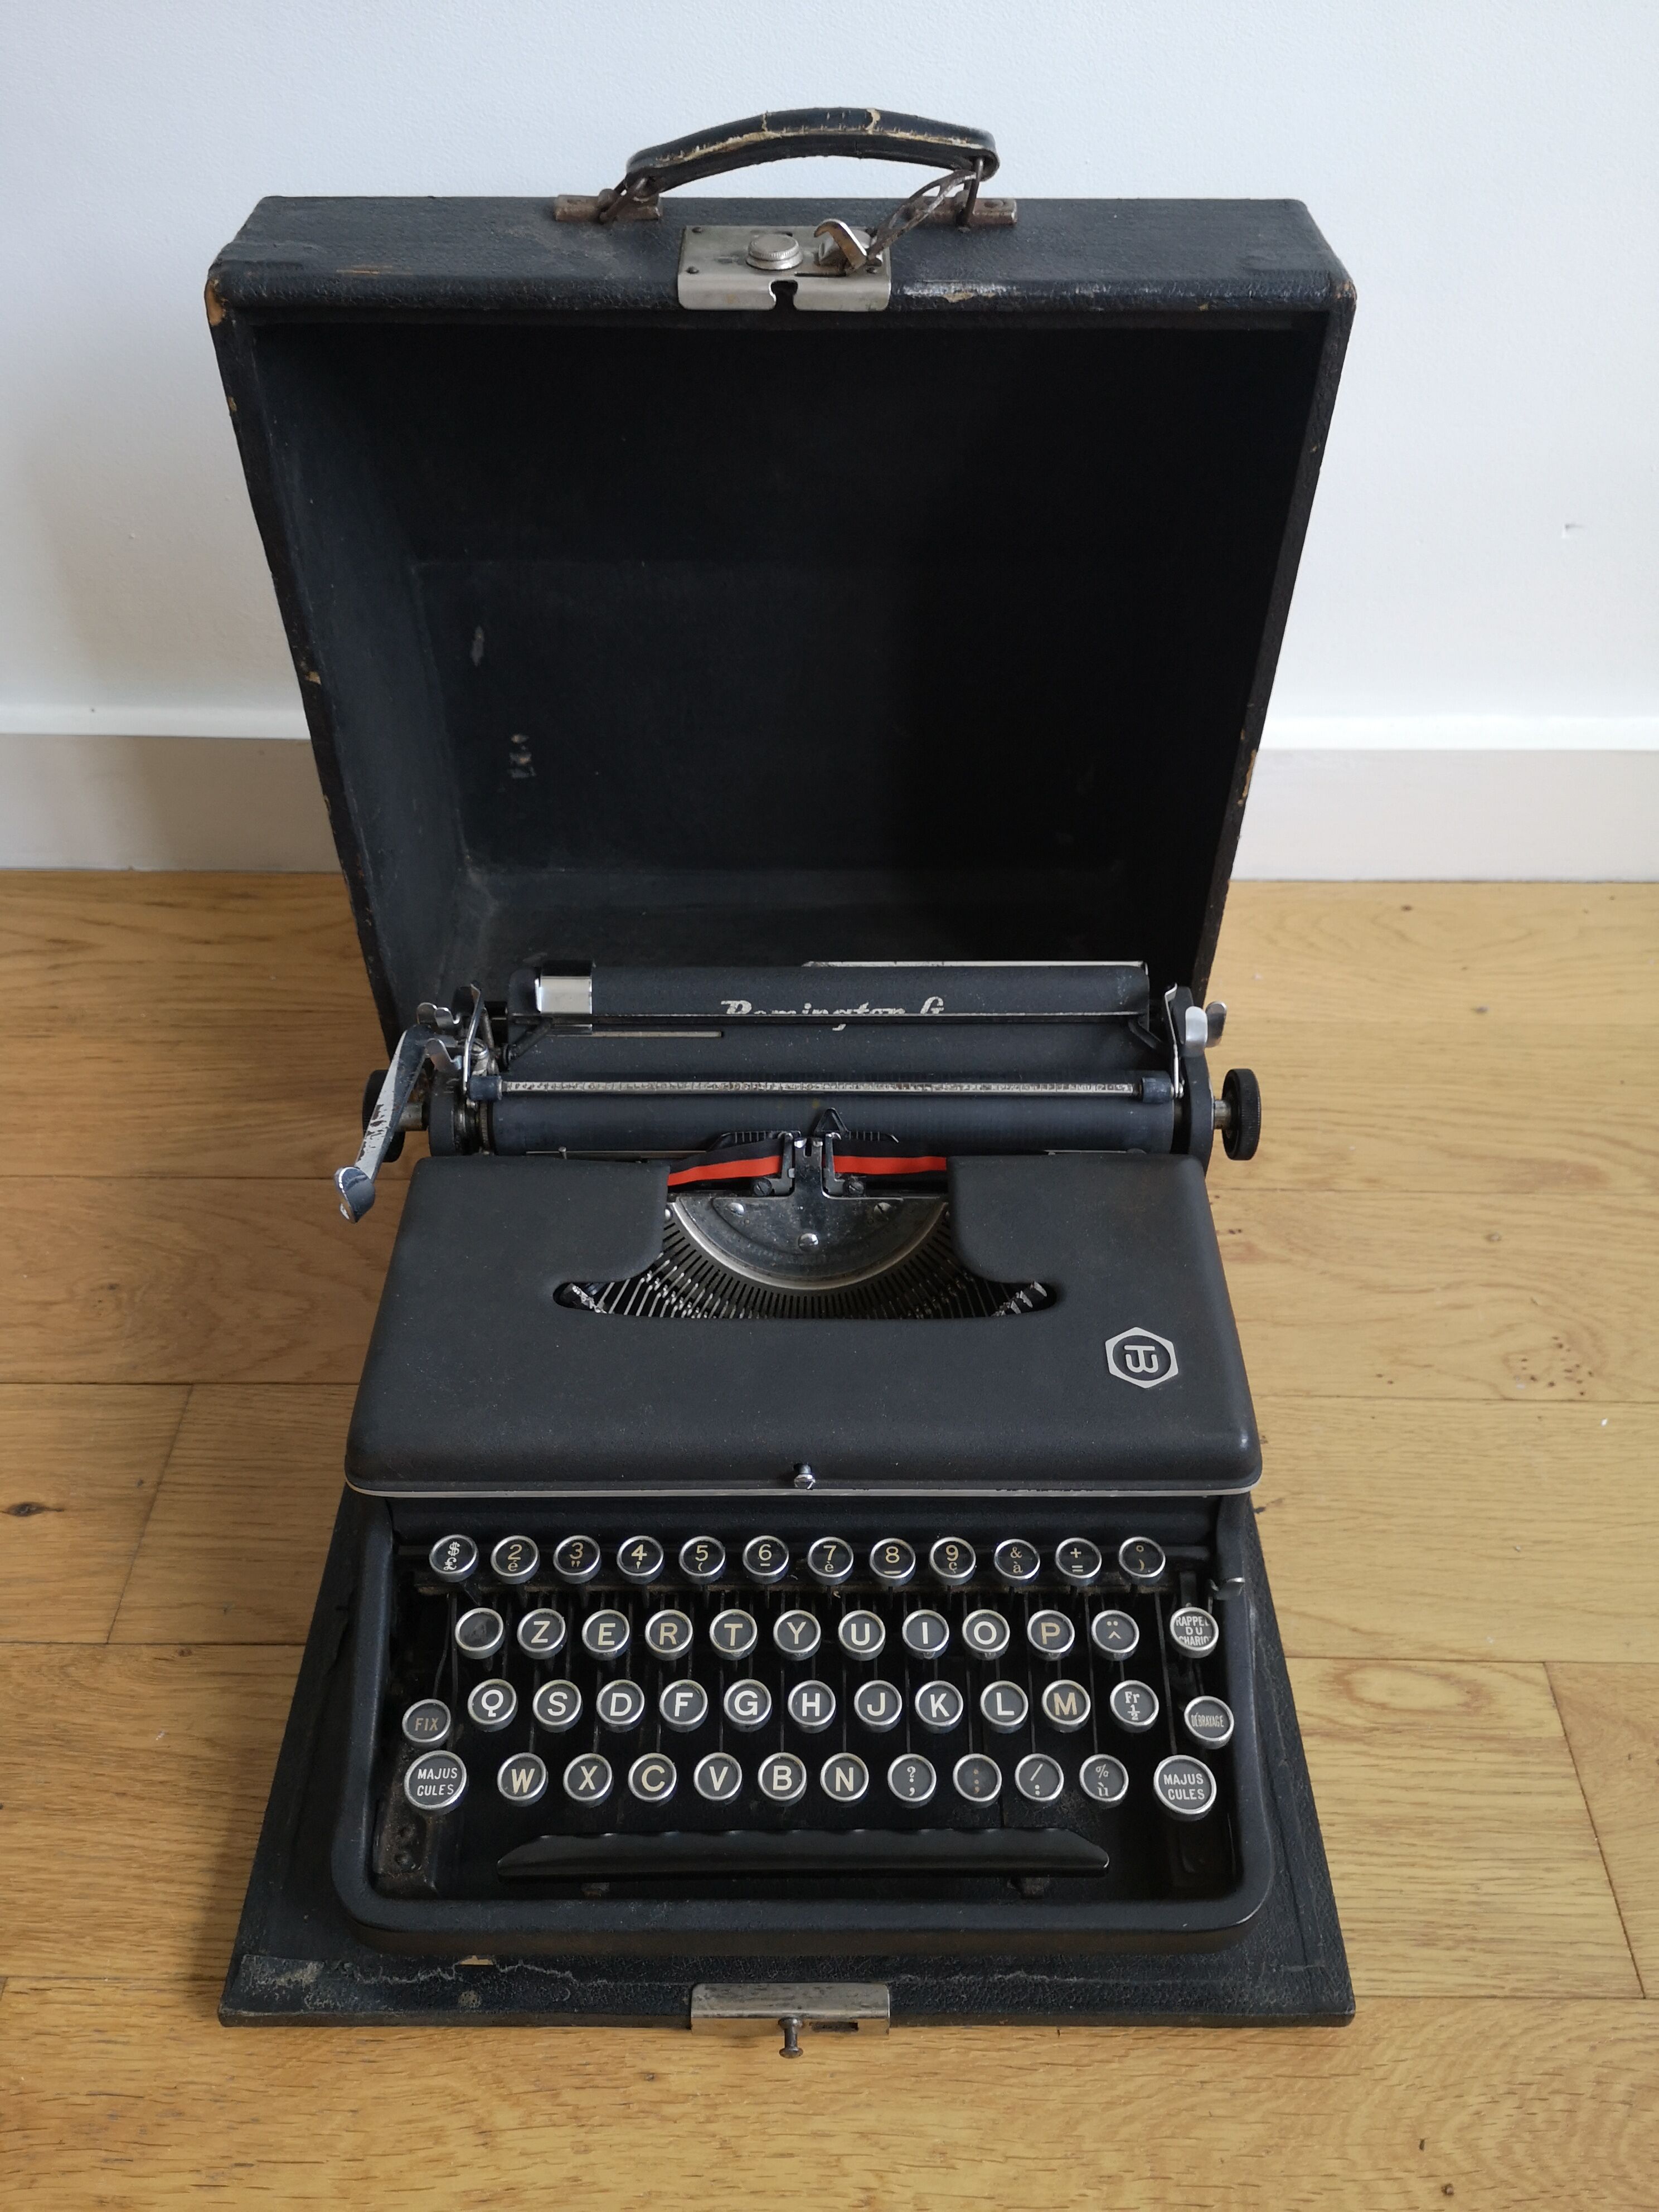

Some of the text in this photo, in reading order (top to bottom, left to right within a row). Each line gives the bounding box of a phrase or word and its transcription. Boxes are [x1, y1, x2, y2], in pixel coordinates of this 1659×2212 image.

[447, 1541, 460, 1557] $
[507, 1544, 522, 1560] 2
[569, 1542, 584, 1560] 3
[631, 1544, 647, 1561] 4
[695, 1545, 709, 1561] 5
[758, 1544, 772, 1561] 6
[823, 1545, 837, 1561] 7
[885, 1546, 900, 1564] 8
[945, 1545, 959, 1561] 9
[1010, 1546, 1022, 1559] &
[443, 1557, 457, 1570] £
[507, 1560, 518, 1572] é
[824, 1561, 834, 1573] è
[948, 1561, 958, 1574] ç
[1013, 1561, 1023, 1574] à
[1175, 1616, 1211, 1627] RAPPEL
[531, 1621, 550, 1643] Z
[598, 1623, 616, 1646] E
[659, 1622, 678, 1645] R
[724, 1623, 743, 1646] T
[787, 1621, 807, 1645] Y
[851, 1623, 870, 1646] U
[922, 1622, 929, 1645] I
[973, 1621, 997, 1646] O
[1041, 1622, 1061, 1645] P
[1185, 1626, 1203, 1636] DU
[1177, 1635, 1211, 1646] HARIO
[481, 1689, 504, 1718] Q
[547, 1691, 568, 1716] S
[610, 1692, 632, 1716] D
[674, 1692, 693, 1717] F
[734, 1690, 758, 1716] G
[802, 1692, 821, 1717] H
[867, 1692, 886, 1716] J
[930, 1693, 950, 1718] K
[996, 1692, 1015, 1716] L
[1053, 1692, 1078, 1716] M
[1124, 1691, 1140, 1704] Fr
[414, 1718, 439, 1731] FIX
[1191, 1712, 1225, 1728] DÉBRAYAGE
[417, 1767, 458, 1780] MAJUS
[511, 1768, 536, 1794] W
[578, 1765, 598, 1791] X
[641, 1764, 665, 1792] C
[709, 1766, 729, 1791] V
[773, 1765, 792, 1791] B
[835, 1767, 854, 1792] N
[907, 1766, 916, 1783] ?
[1163, 1773, 1204, 1785] MAJUS
[416, 1783, 454, 1797] CULES
[1097, 1782, 1109, 1797] ù
[1167, 1788, 1205, 1801] CULES
